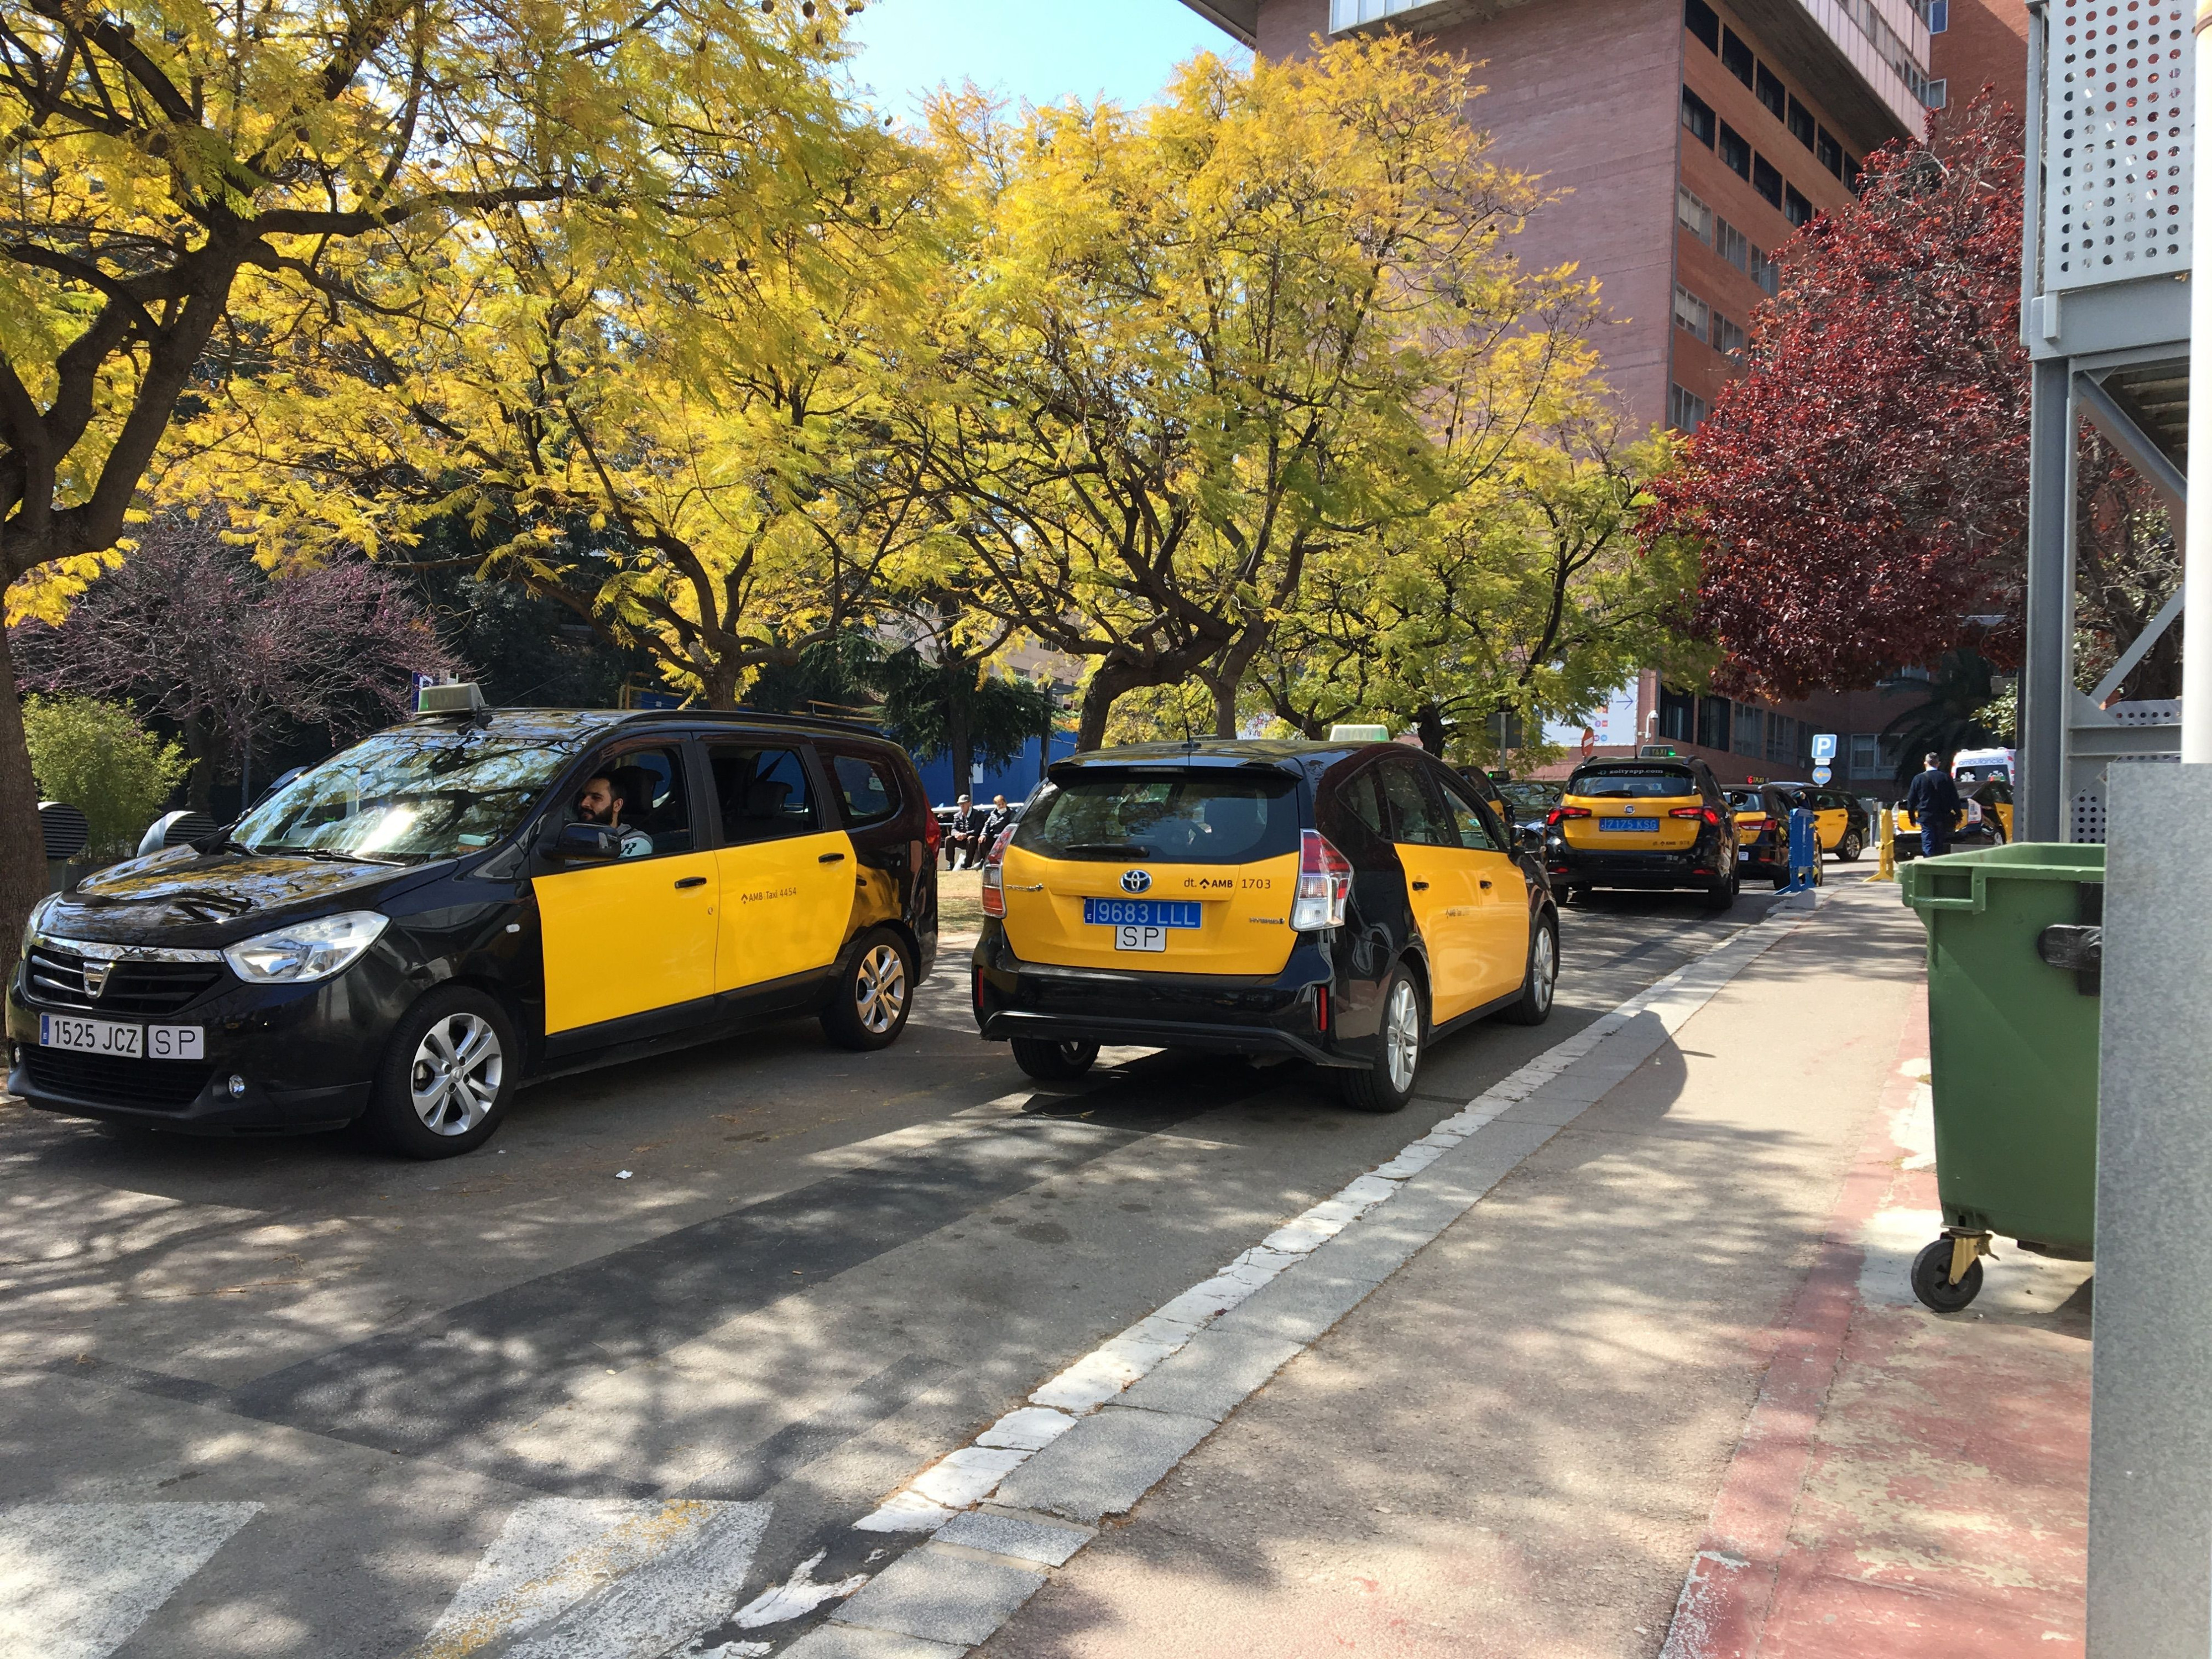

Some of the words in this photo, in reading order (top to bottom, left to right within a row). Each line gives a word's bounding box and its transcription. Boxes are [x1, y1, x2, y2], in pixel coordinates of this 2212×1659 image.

[1817, 738, 1832, 755] P
[1608, 820, 1633, 828] 7175
[1637, 820, 1656, 829] KSG
[1184, 878, 1197, 888] dt.
[1211, 880, 1233, 888] AMB
[1241, 879, 1271, 889] 1703
[749, 892, 763, 902] AMB
[765, 890, 778, 900] Taxi
[779, 887, 797, 898] 4454
[1098, 902, 1149, 924] 9683
[1156, 904, 1196, 925] LLL
[1123, 926, 1159, 947] SP
[55, 1020, 95, 1048] 1525
[102, 1026, 137, 1053] JCZ
[155, 1030, 196, 1055] SP
